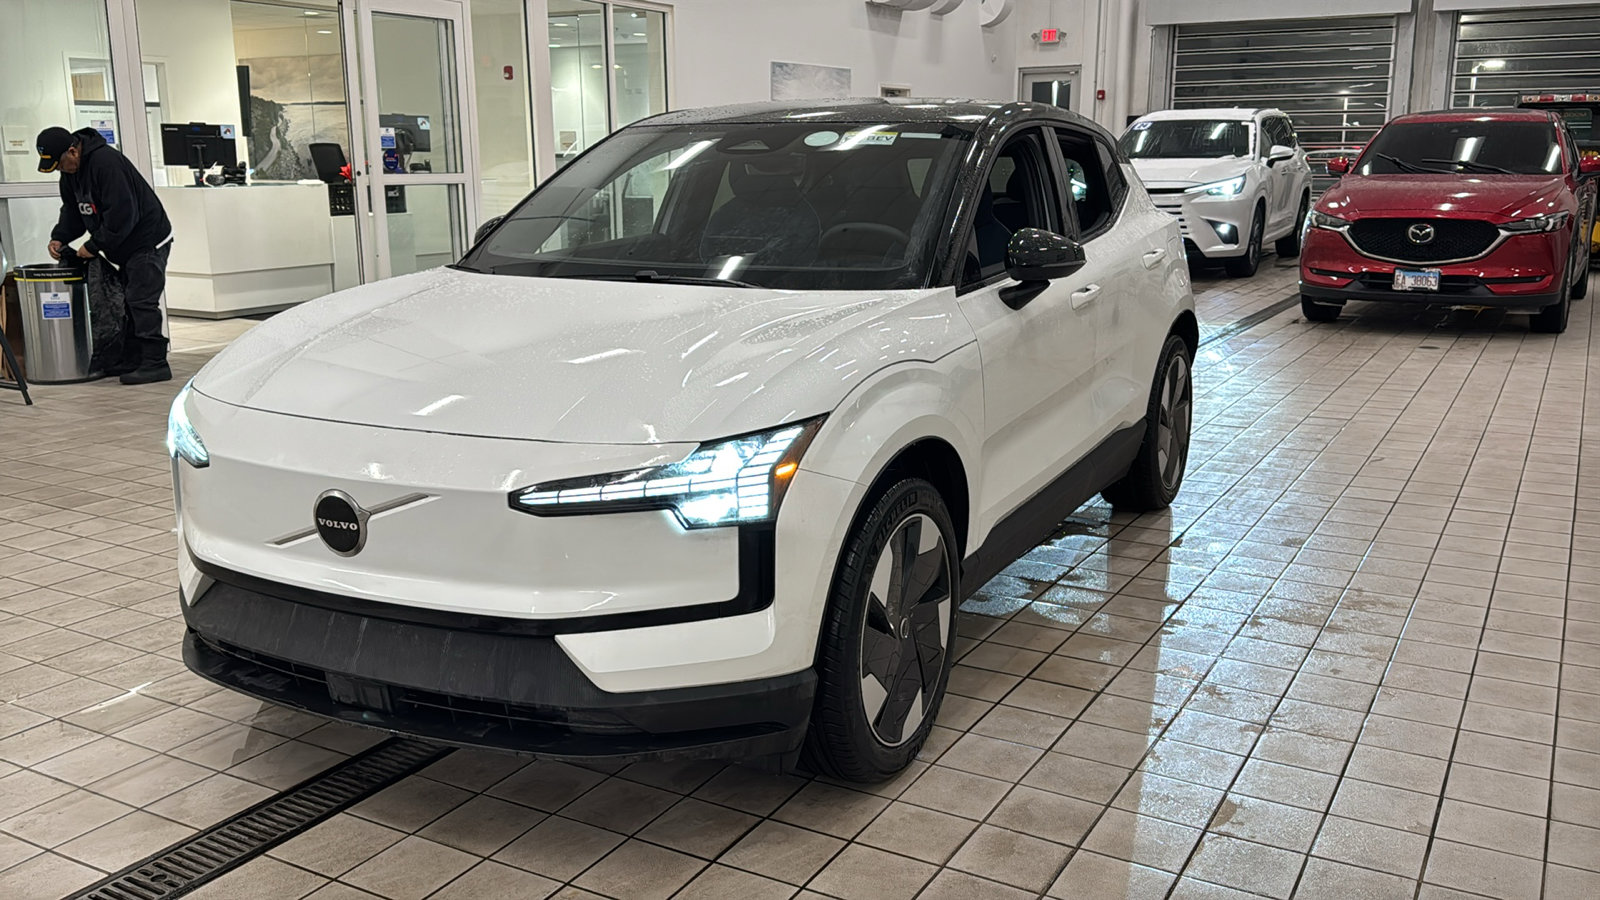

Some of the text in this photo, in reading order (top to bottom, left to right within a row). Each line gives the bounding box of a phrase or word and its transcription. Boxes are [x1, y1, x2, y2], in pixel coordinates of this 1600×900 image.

[1042, 29, 1056, 42] EXIT
[1411, 275, 1438, 287] 38063
[318, 518, 358, 530] VOLVO
[872, 491, 918, 553] MICHELIN
